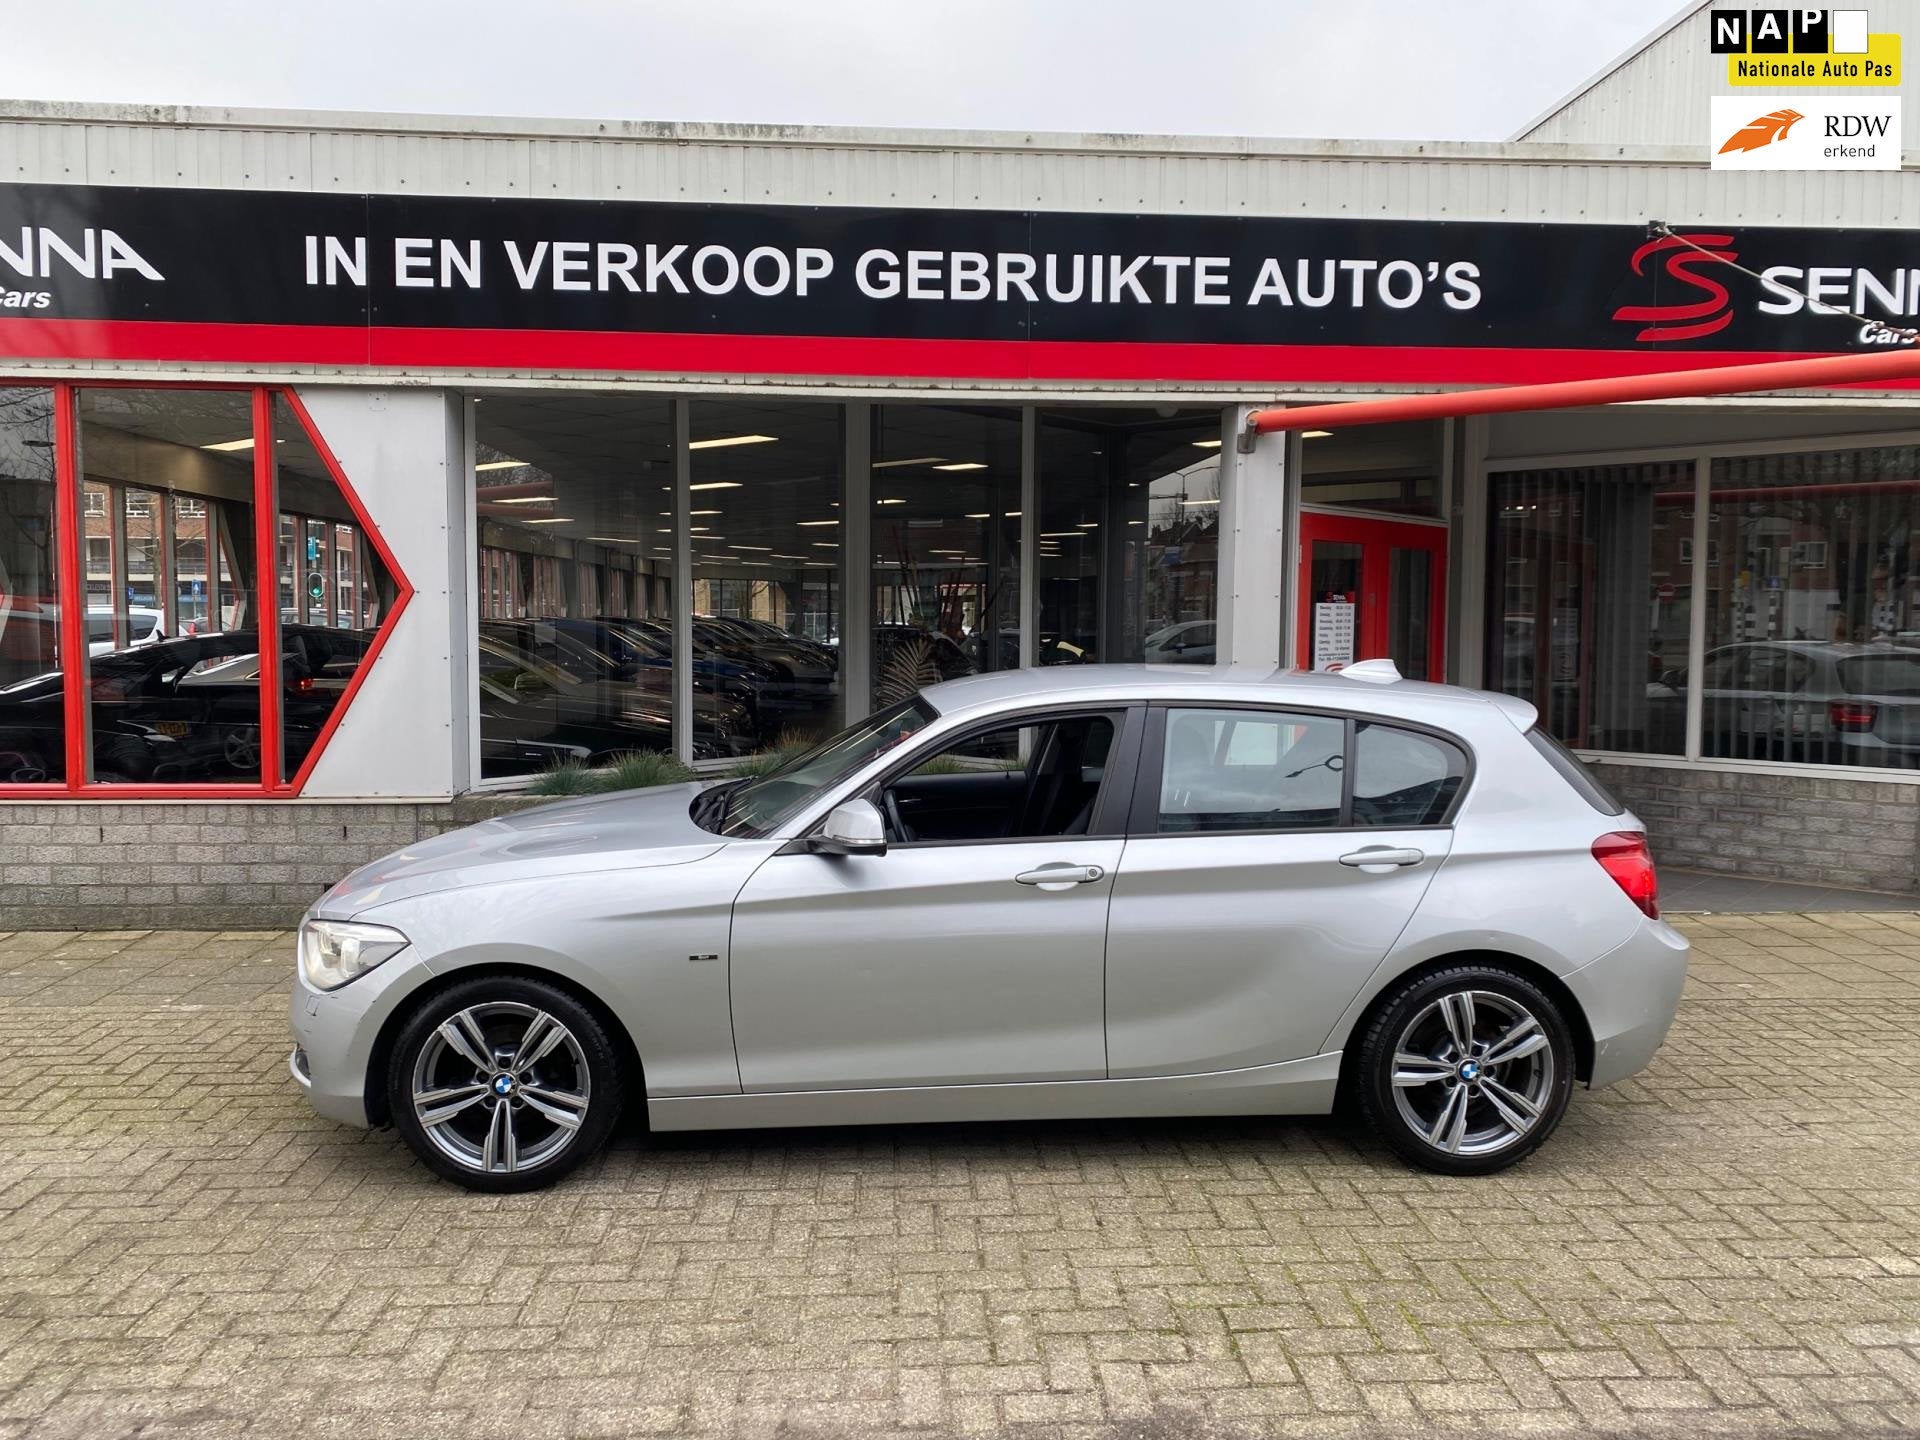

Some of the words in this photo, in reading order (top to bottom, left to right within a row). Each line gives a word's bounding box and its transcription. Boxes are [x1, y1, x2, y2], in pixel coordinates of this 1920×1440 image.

[305, 235, 367, 286] IN
[394, 237, 481, 289] EN
[503, 240, 834, 297] VERKOOP
[855, 248, 1231, 305] GEBRUIKTE
[1758, 265, 1920, 316] SEN
